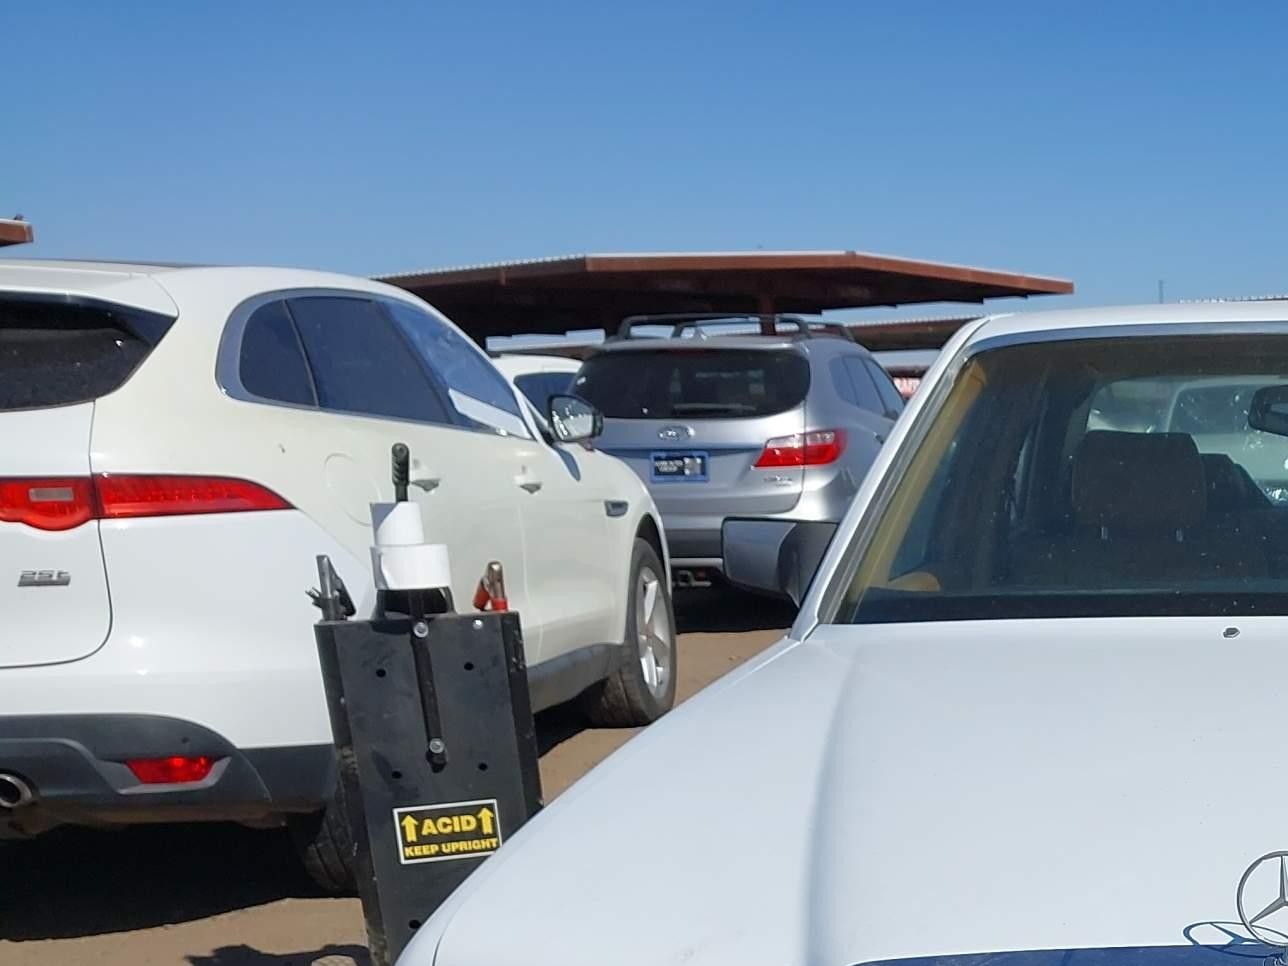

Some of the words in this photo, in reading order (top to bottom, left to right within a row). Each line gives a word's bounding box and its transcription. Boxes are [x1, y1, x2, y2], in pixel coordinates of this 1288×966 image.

[421, 814, 477, 836] ACID
[404, 844, 439, 858] KEEP
[441, 838, 498, 854] UPRIGHT
